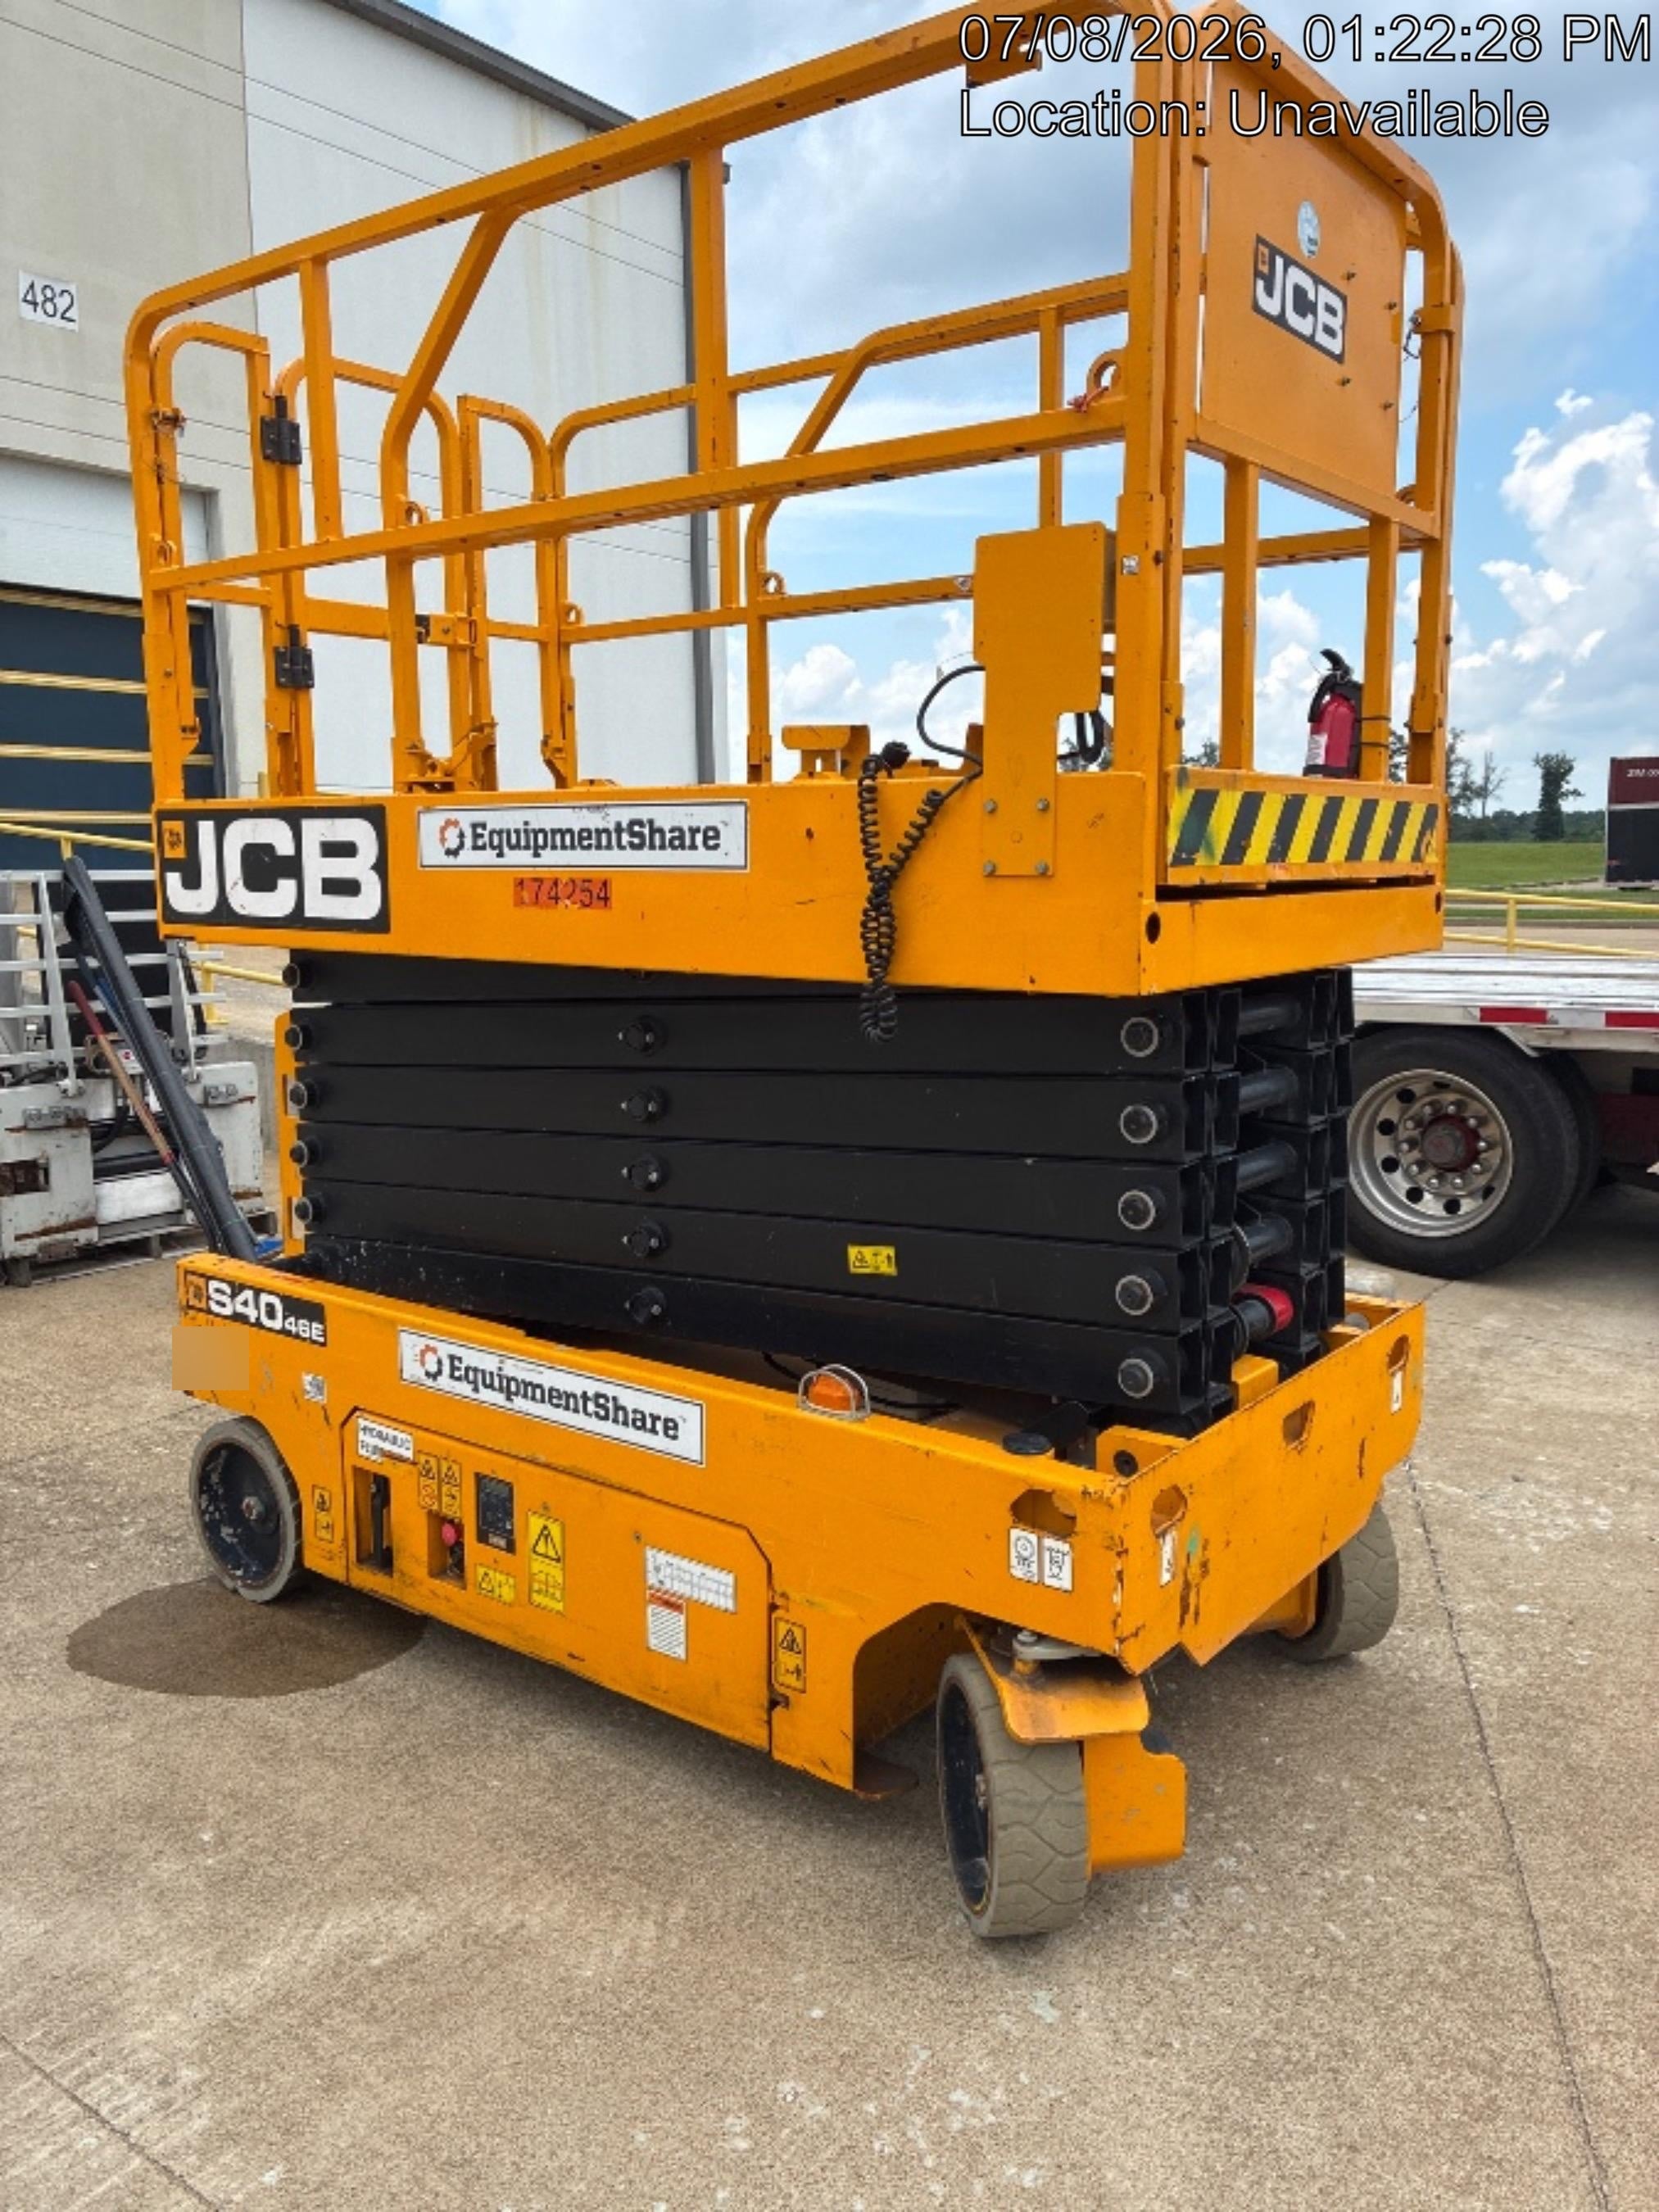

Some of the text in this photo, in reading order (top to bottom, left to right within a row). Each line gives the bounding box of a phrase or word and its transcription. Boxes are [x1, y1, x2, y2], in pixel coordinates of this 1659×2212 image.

[21, 279, 77, 323] 482
[1255, 254, 1344, 356] JCB
[469, 818, 722, 859] EquipmentShare
[165, 817, 382, 920] JCB
[517, 877, 611, 908] 174254
[206, 1278, 284, 1331] S40
[447, 1353, 680, 1442] EquipmentShare
